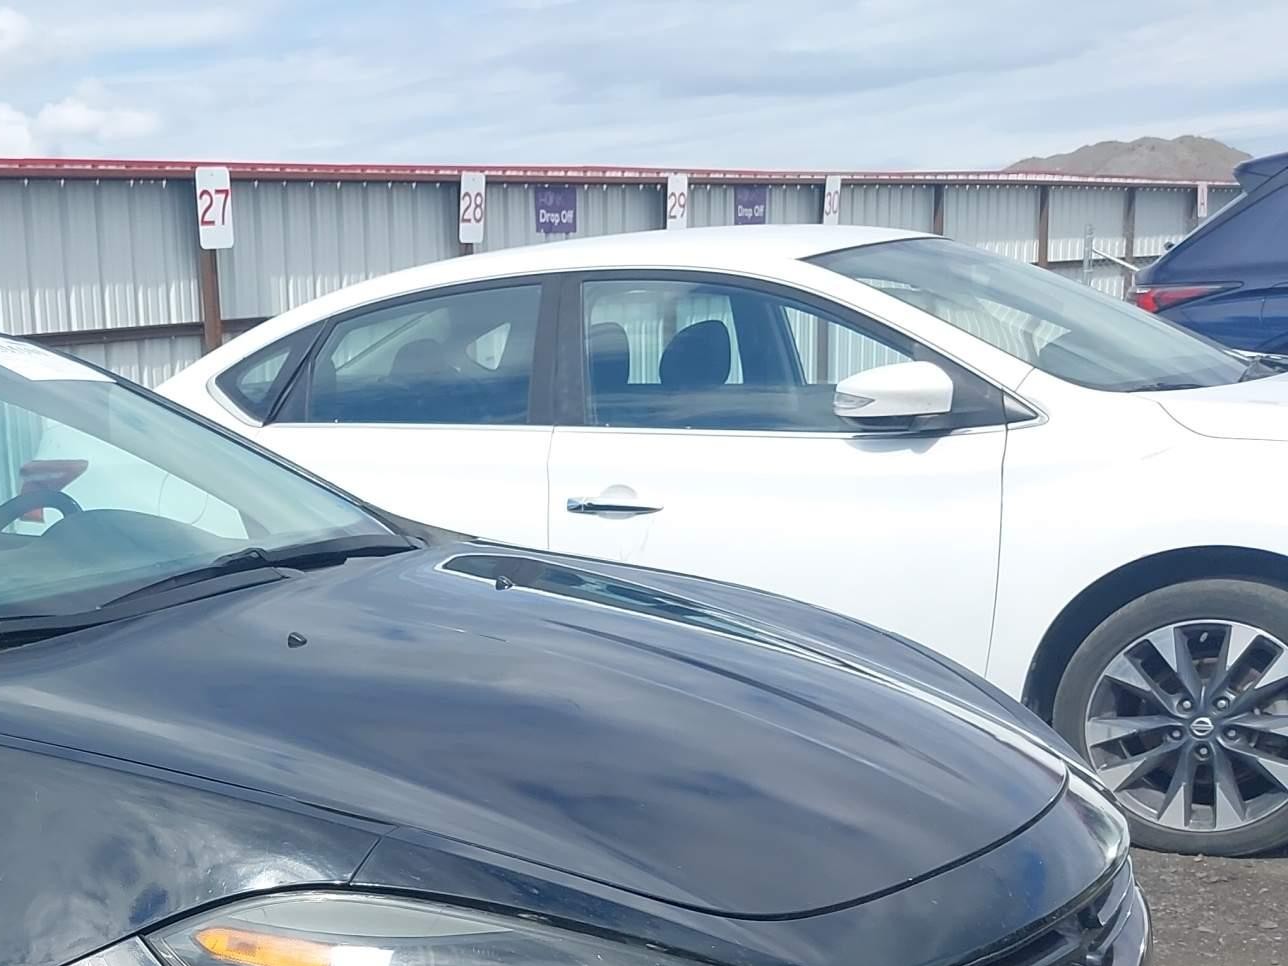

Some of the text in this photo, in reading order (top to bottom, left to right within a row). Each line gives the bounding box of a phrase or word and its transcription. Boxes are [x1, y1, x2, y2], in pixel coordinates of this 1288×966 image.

[199, 188, 232, 226] 27
[461, 191, 484, 223] 28
[668, 191, 686, 219] 29
[737, 204, 753, 220] Drop
[825, 190, 840, 216] 30
[539, 209, 574, 226] Drop Off
